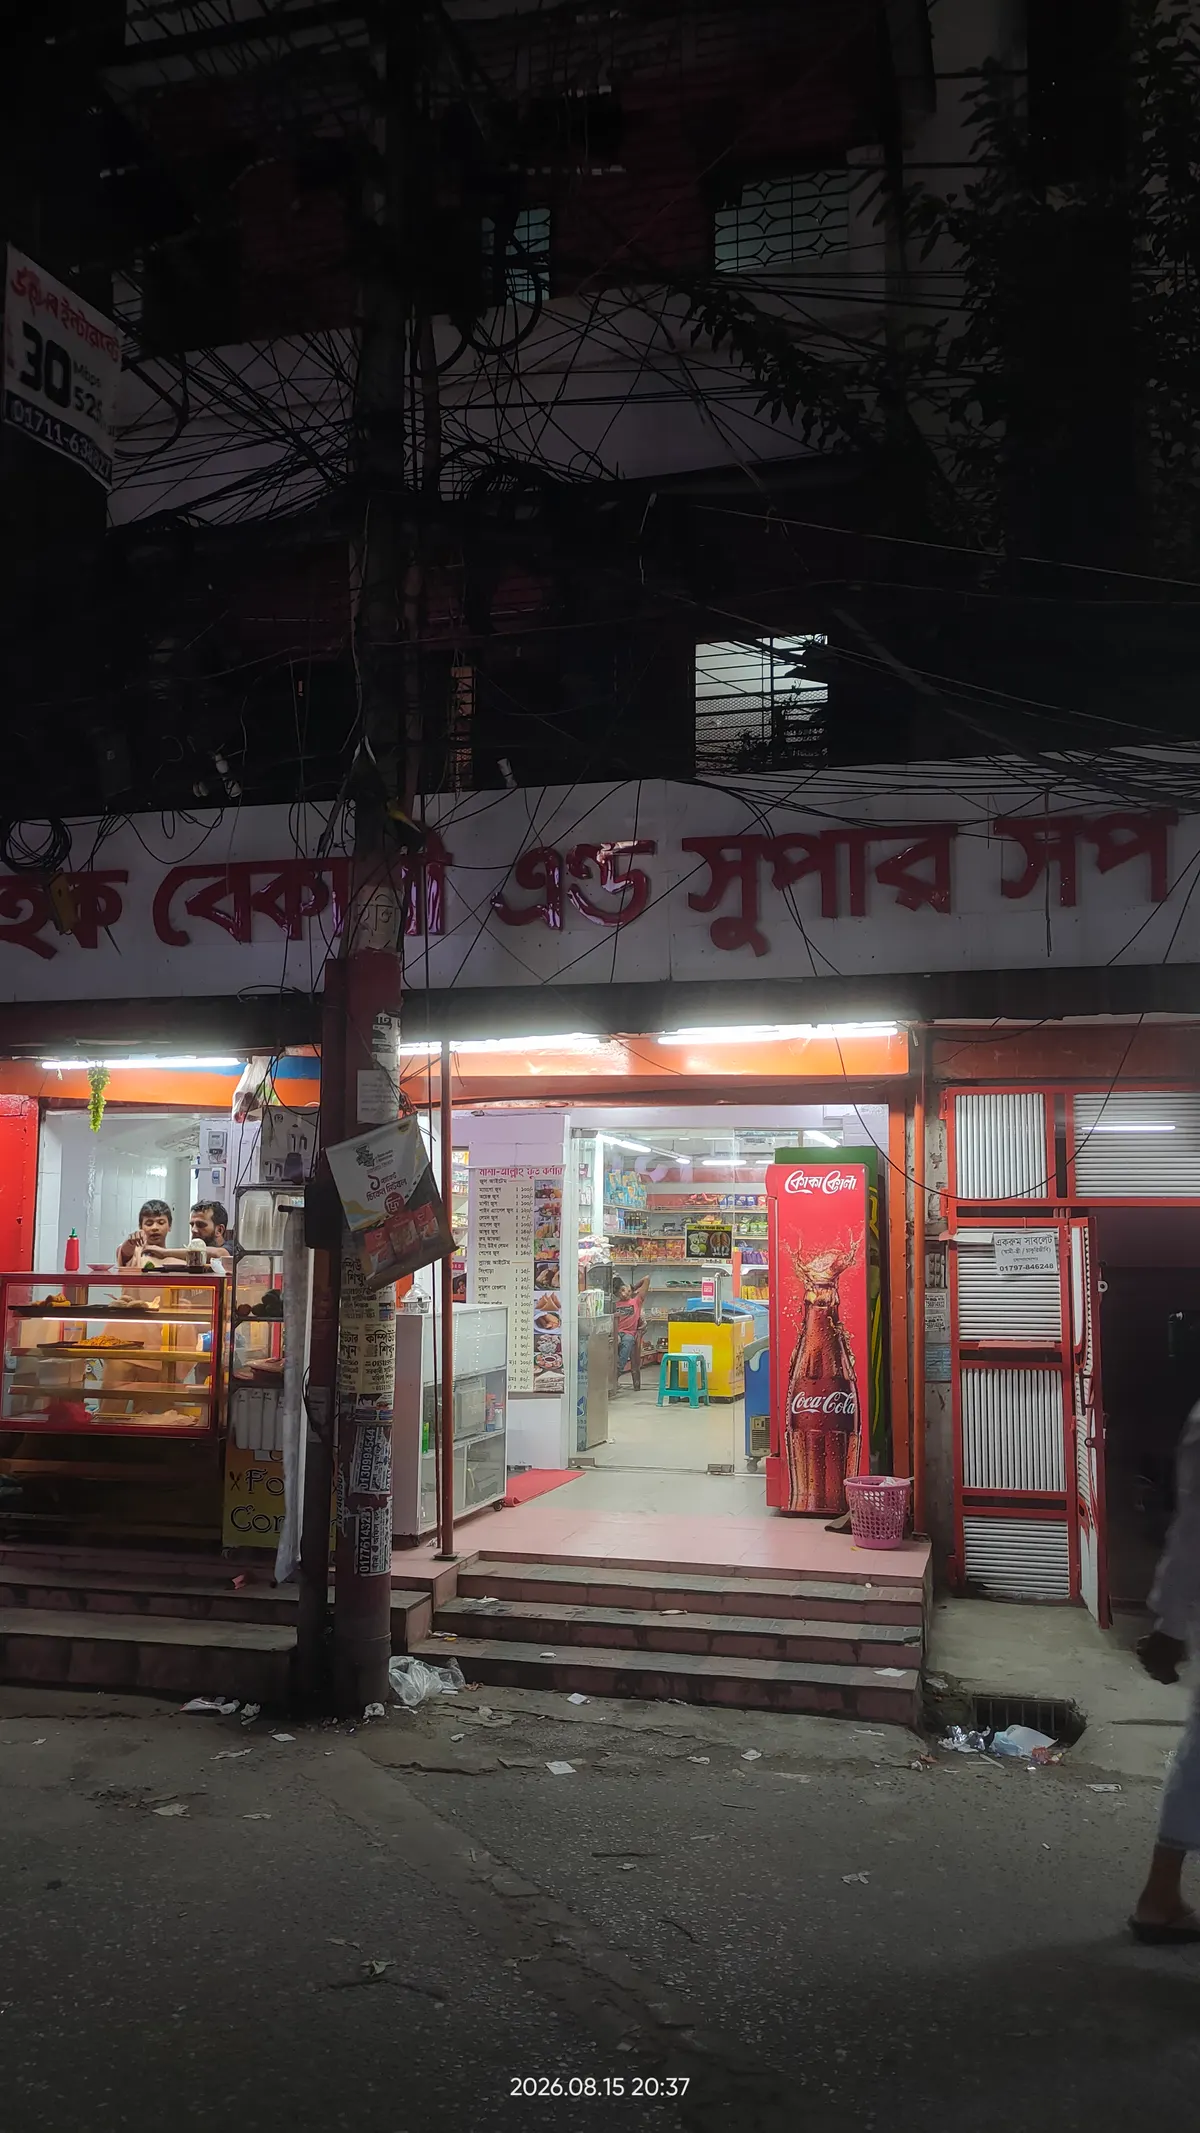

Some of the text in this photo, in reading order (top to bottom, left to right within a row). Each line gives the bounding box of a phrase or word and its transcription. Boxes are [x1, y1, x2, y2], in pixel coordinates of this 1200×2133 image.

[20, 320, 72, 409] 30
[152, 823, 453, 948] বেকাী
[682, 823, 958, 957] সুপার
[994, 808, 1179, 907] সপ
[1024, 1234, 1053, 1246] সাবলেট
[791, 1391, 856, 1415] Coca-Cola
[244, 1468, 286, 1496] Fo
[231, 1504, 286, 1534] Cor
